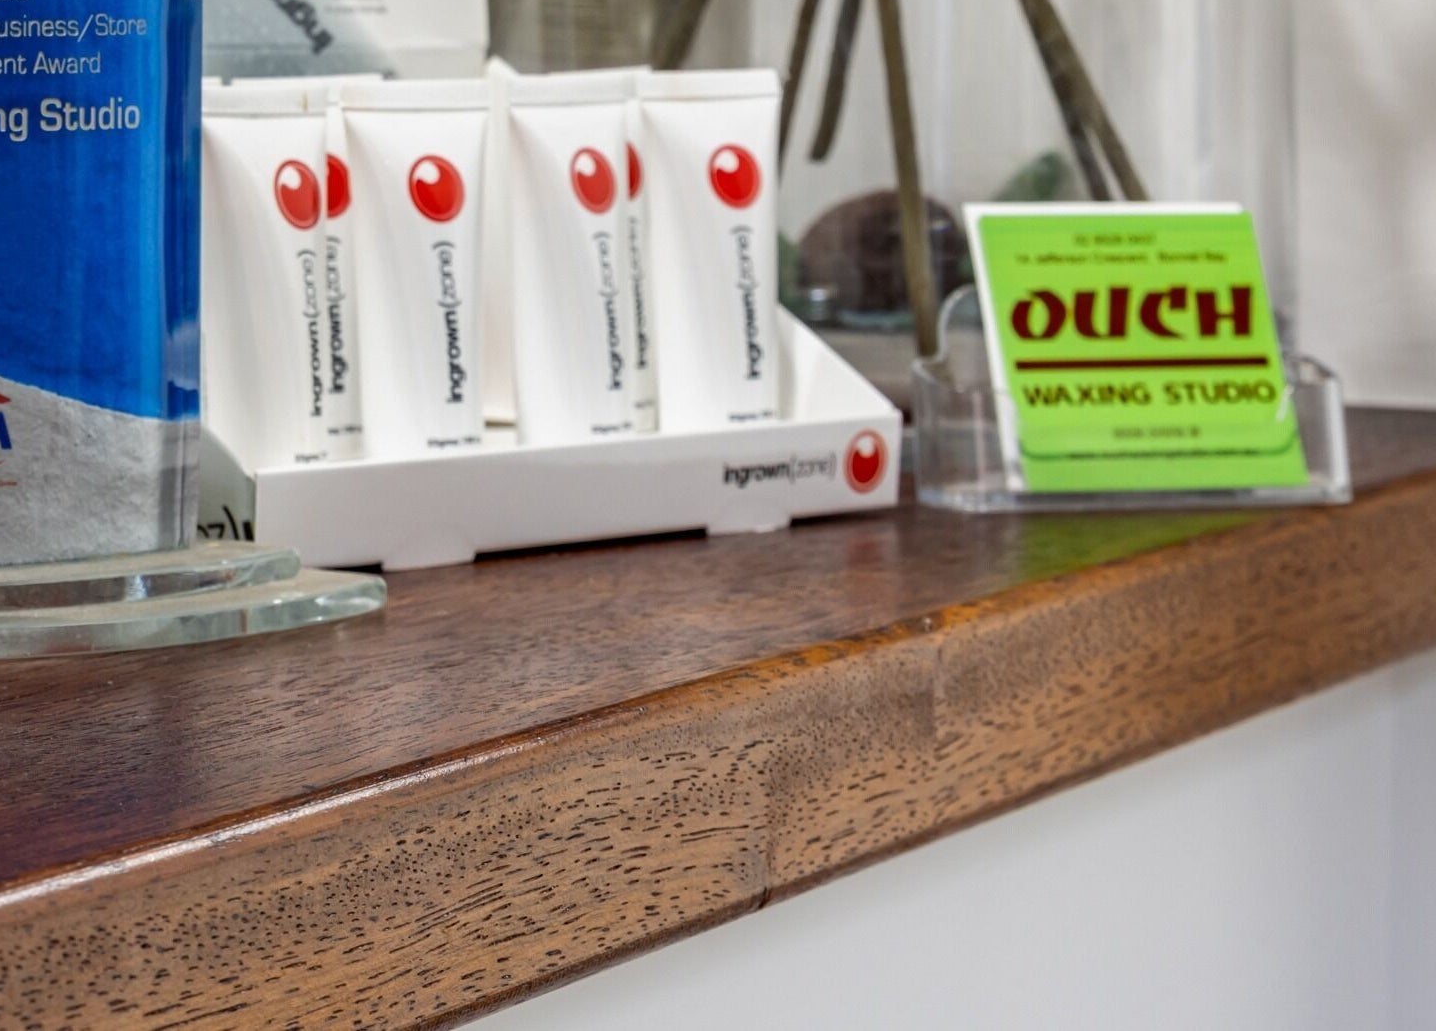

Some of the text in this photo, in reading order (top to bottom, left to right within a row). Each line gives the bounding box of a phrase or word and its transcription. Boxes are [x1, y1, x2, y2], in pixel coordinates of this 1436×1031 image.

[32, 51, 101, 75] Award
[40, 97, 141, 132] Studio
[1011, 286, 1251, 340] OUCH
[1022, 380, 1276, 407] WAXING STUDIO
